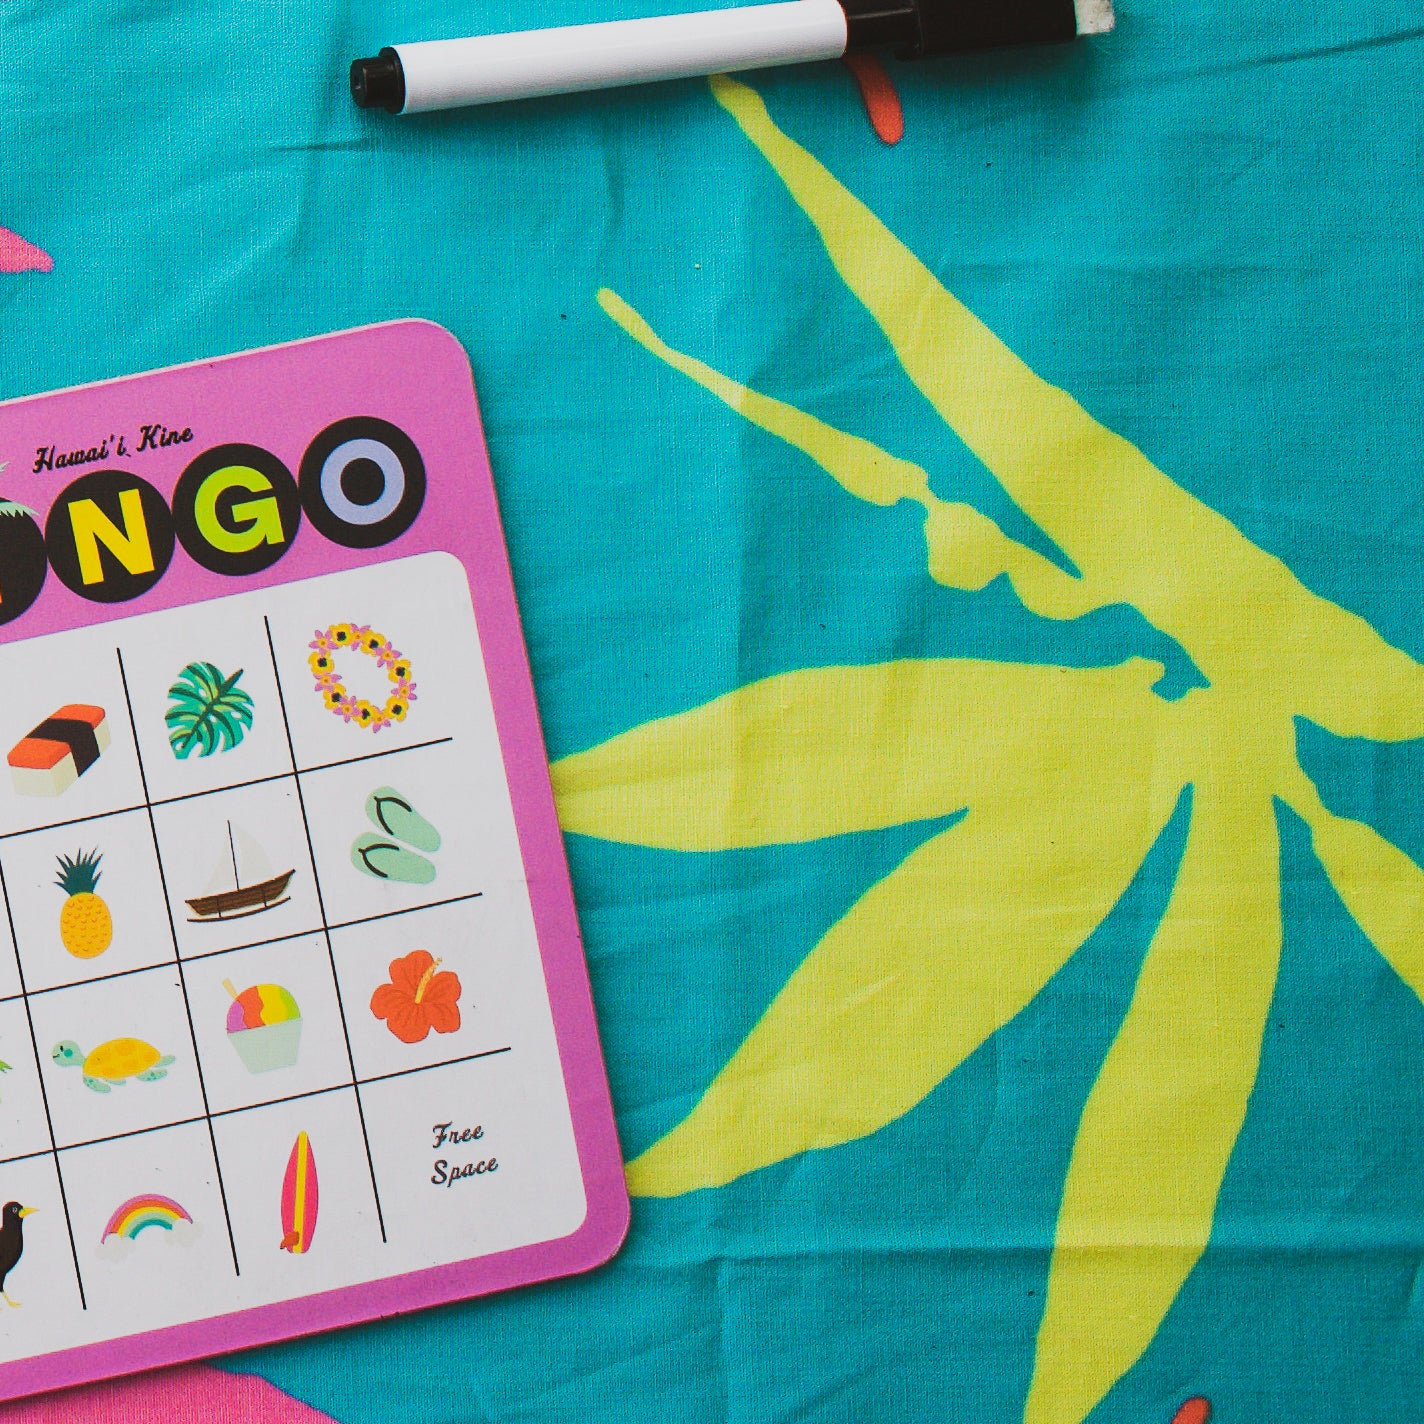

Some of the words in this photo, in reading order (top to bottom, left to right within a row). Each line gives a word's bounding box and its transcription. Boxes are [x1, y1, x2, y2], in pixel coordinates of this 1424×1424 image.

[136, 423, 194, 453] Kine
[432, 1120, 485, 1149] Free
[430, 1157, 499, 1189] Space
